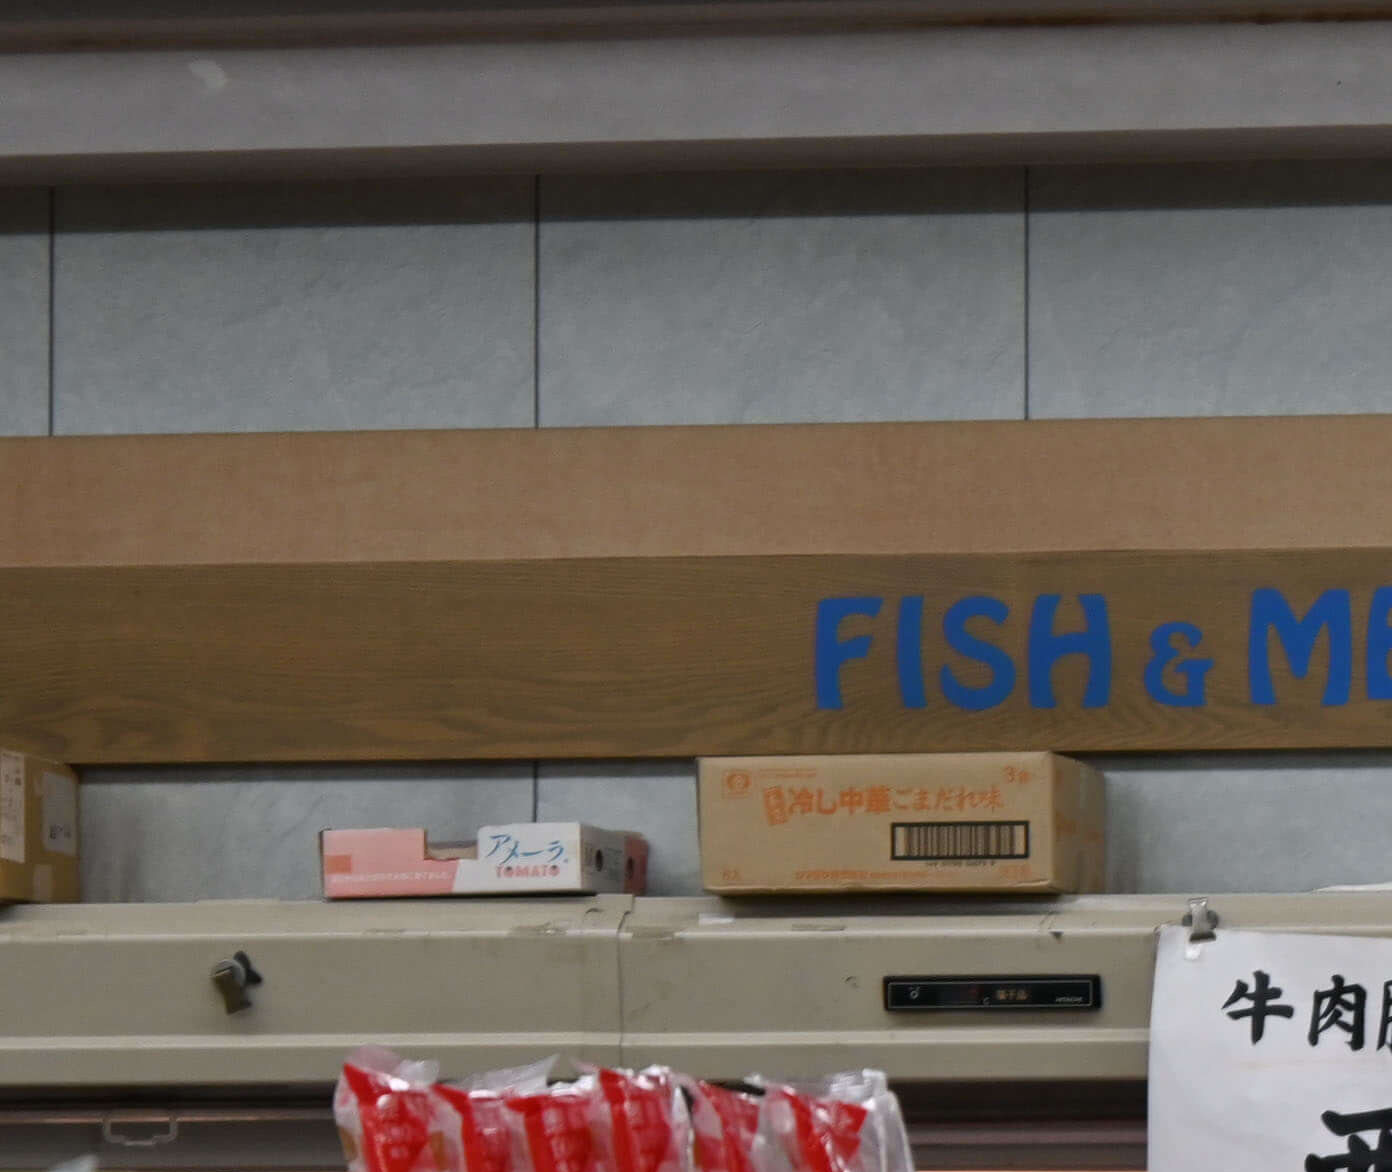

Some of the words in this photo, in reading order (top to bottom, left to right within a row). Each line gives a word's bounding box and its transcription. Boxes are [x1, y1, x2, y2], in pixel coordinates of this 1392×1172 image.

[812, 592, 1112, 711] FISH
[1144, 620, 1214, 708] &
[496, 864, 560, 879] TOMATO
